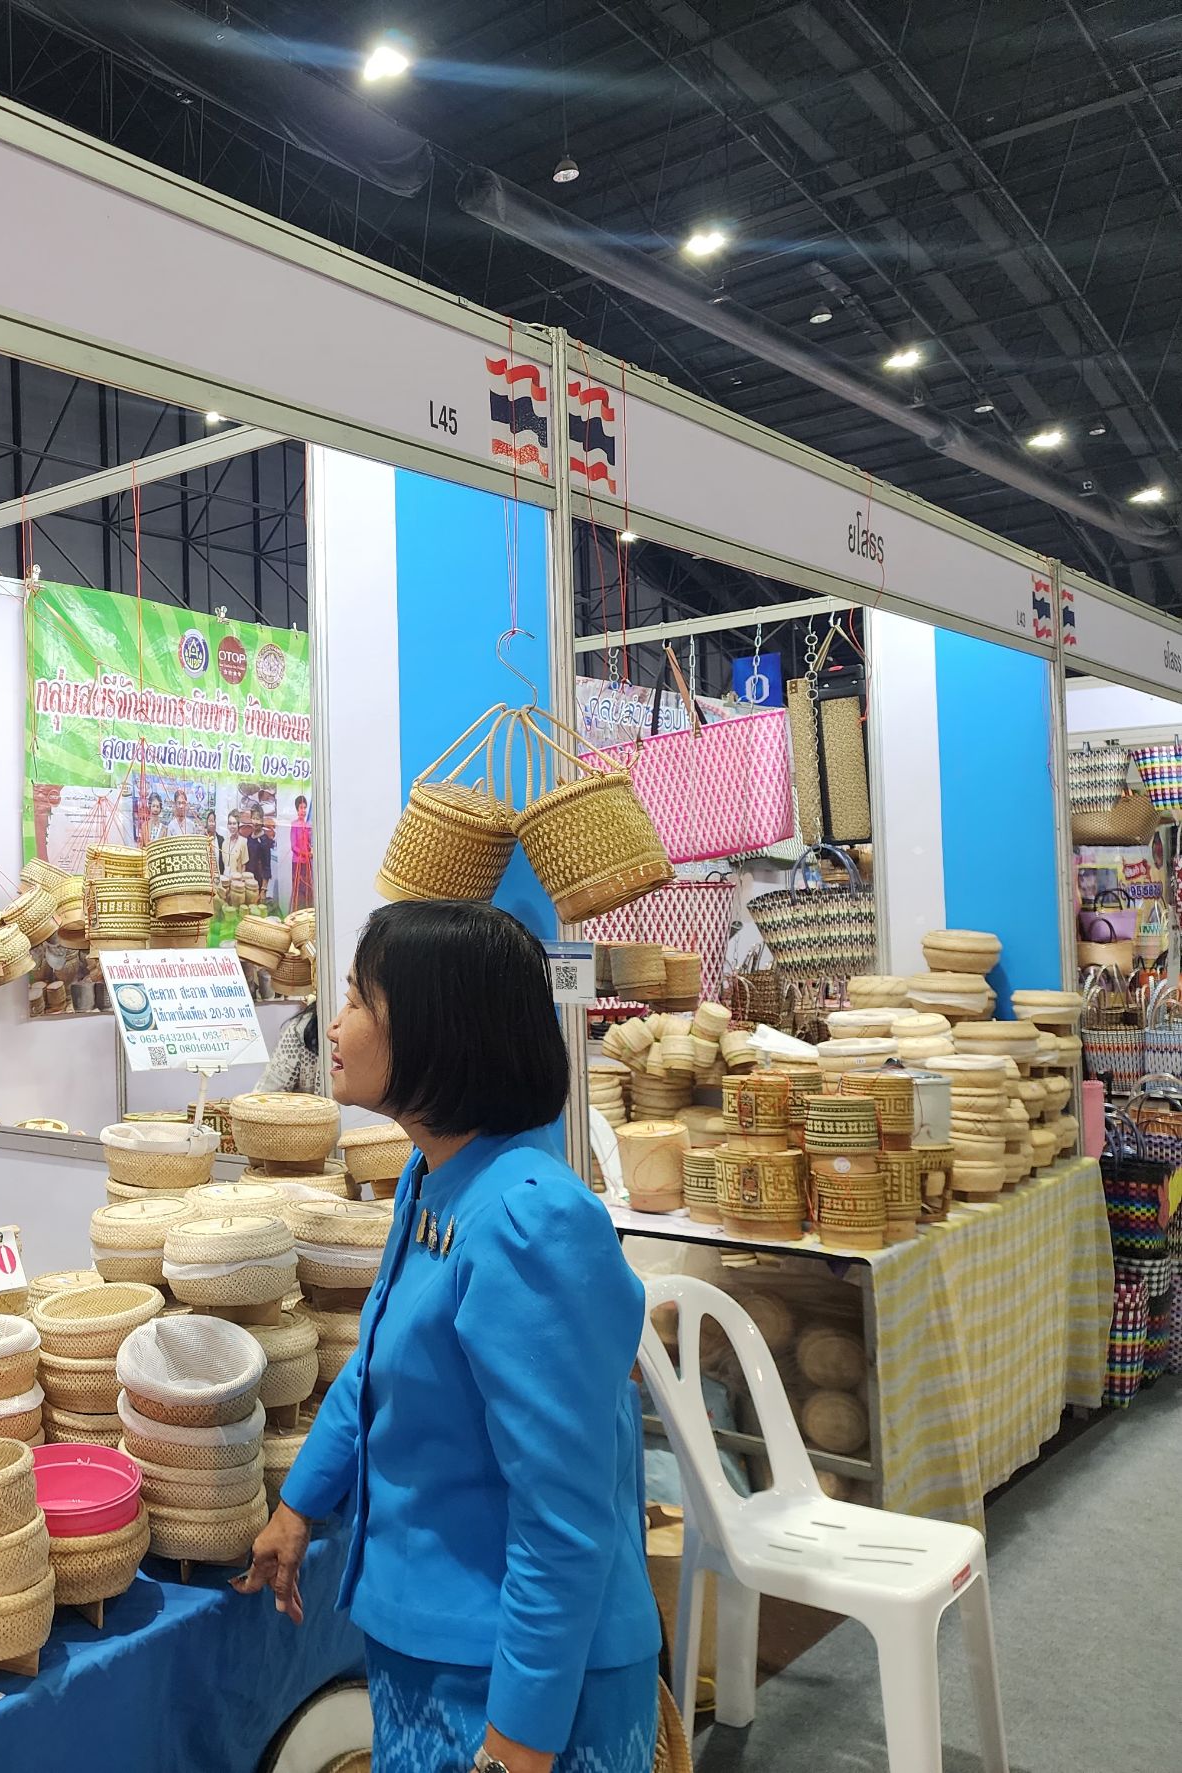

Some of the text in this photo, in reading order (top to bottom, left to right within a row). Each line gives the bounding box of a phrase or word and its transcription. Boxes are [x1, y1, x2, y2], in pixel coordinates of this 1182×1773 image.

[429, 399, 458, 436] L45
[847, 510, 885, 565] ยโสธร
[218, 650, 246, 664] OTOP
[209, 1006, 236, 1019] 20-30
